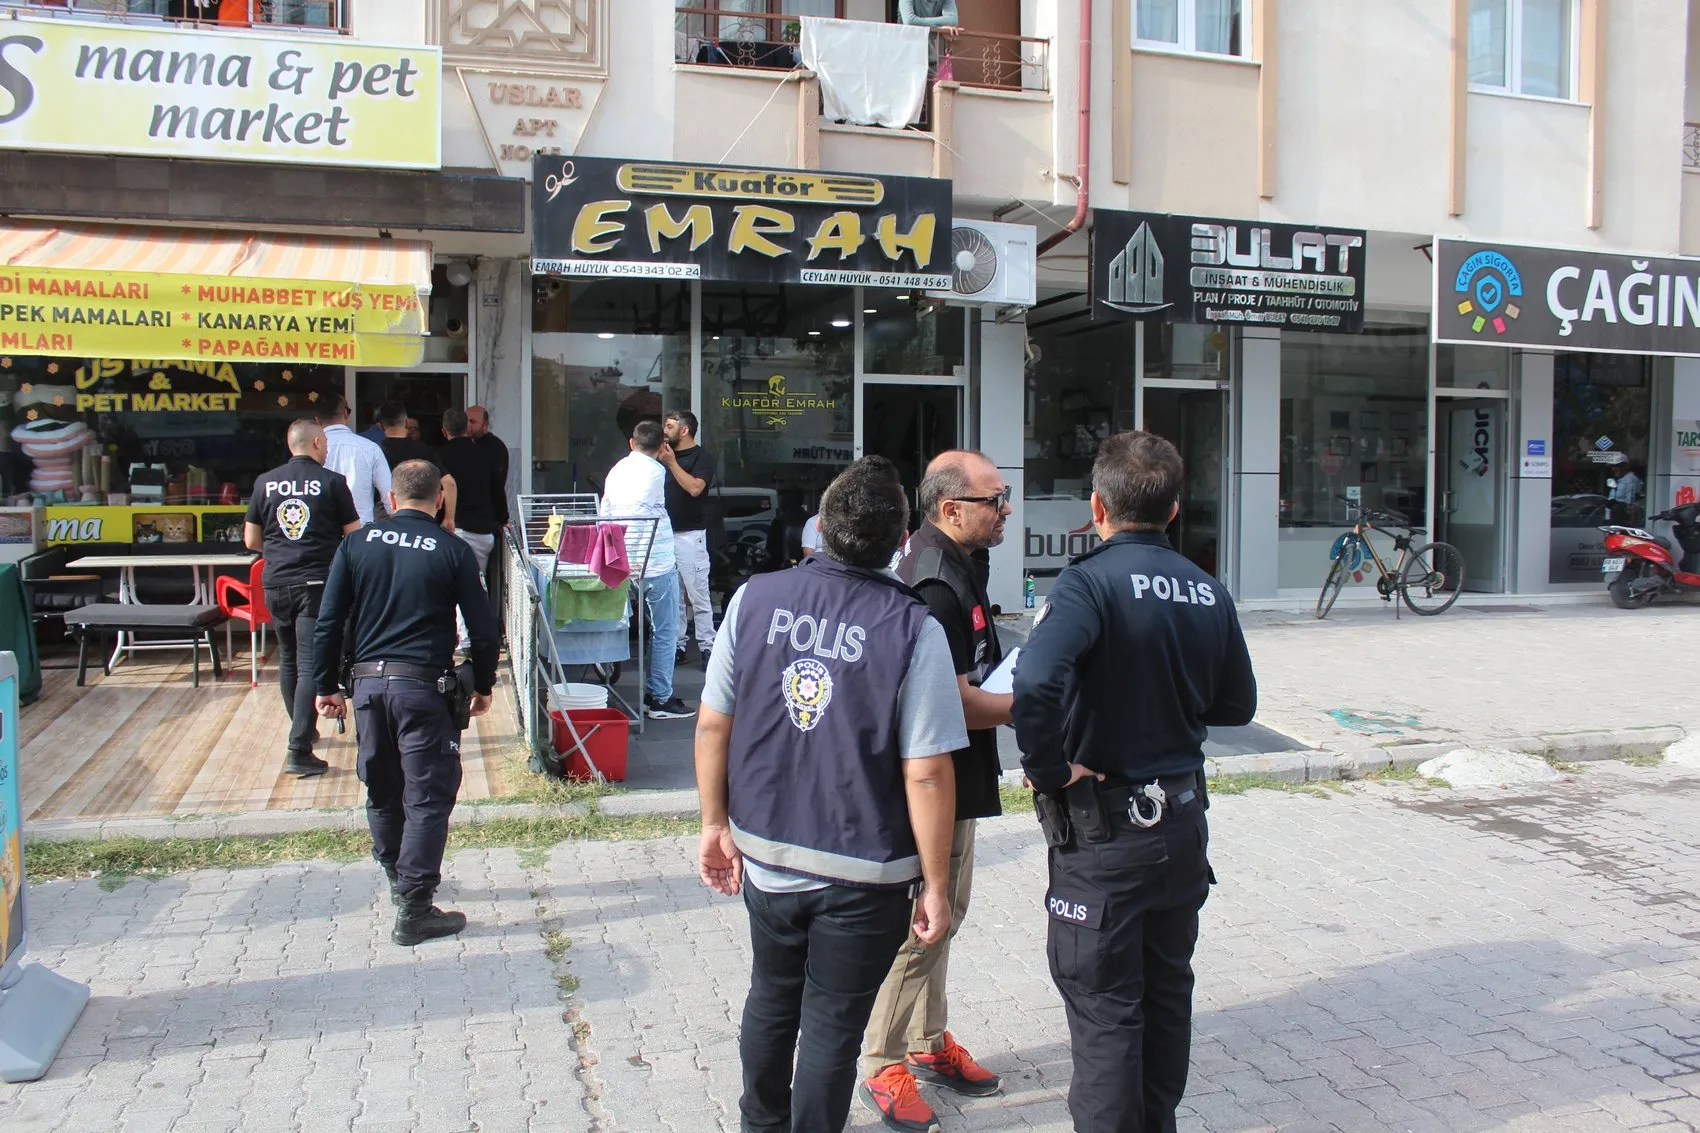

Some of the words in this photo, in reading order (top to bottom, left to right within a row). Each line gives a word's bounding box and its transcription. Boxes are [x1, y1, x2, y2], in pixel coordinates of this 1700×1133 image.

[75, 44, 252, 88] mama
[268, 50, 313, 95] &
[327, 58, 418, 101] pet
[488, 82, 582, 109] USLAR
[148, 103, 350, 146] market
[513, 118, 558, 137] APT
[693, 172, 814, 196] Kuaför
[570, 199, 936, 270] EMRAH
[1191, 223, 1362, 273] BULAT
[535, 261, 570, 274] EMRAH
[28, 278, 149, 299] MAMALARI
[803, 272, 837, 282] CEYLAN
[839, 271, 871, 284] HÜYÜK
[879, 277, 900, 286] 0541
[904, 277, 920, 286] 448
[923, 278, 934, 287] 45
[936, 278, 947, 287] 65
[1252, 276, 1261, 287] &
[198, 285, 316, 306] MUHABBET
[322, 291, 363, 310] KUŞ
[1194, 292, 1218, 303] PLAN
[1228, 294, 1256, 306] PROJE
[1546, 260, 1700, 337] ÇAĞIN
[0, 304, 46, 322] PEK
[52, 306, 171, 327] MAMALARI
[198, 312, 300, 332] KANARYA
[305, 314, 355, 333] YEMİ
[1, 332, 73, 351] MLARI
[198, 337, 299, 357] PAPAĞAN
[305, 339, 355, 360] YEMİ
[148, 372, 172, 390] &
[76, 393, 128, 412] PET
[132, 392, 241, 412] MARKET
[721, 396, 780, 408] KUAFÖR
[786, 398, 835, 409] EMRAH
